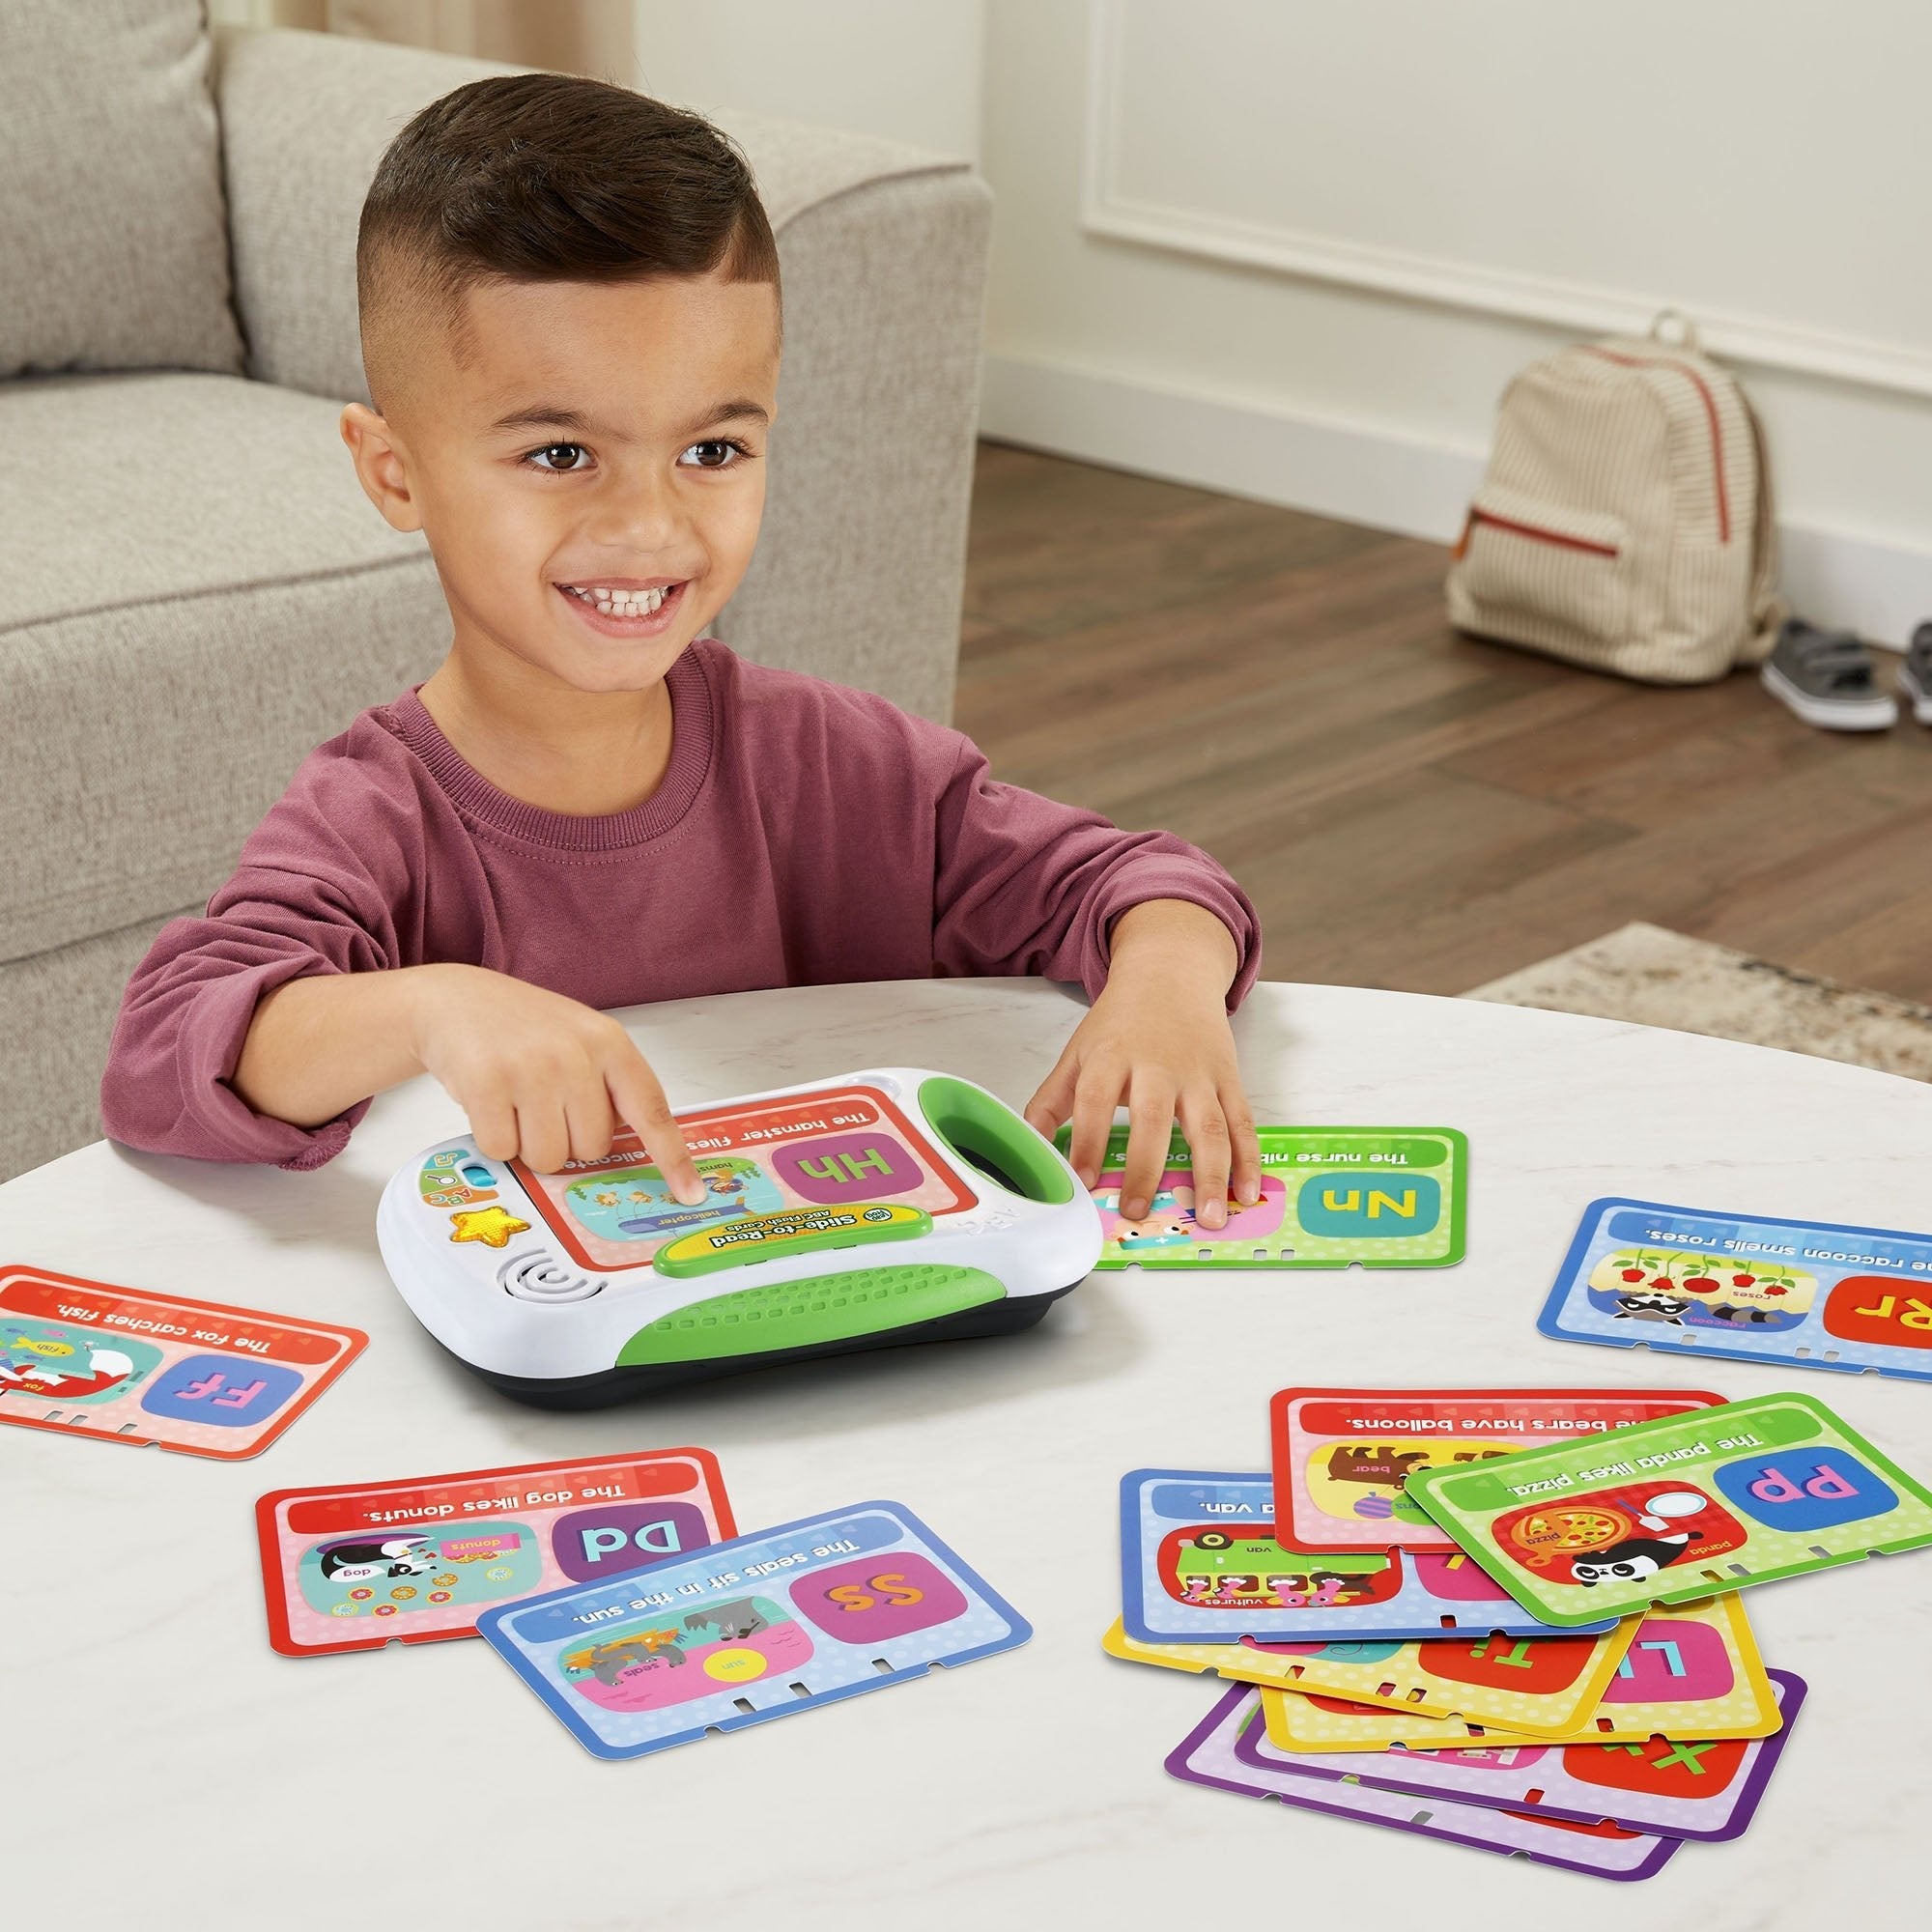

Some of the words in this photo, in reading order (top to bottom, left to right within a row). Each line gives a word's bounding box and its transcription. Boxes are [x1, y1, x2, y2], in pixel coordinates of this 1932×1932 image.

[832, 1111, 870, 1128] The
[741, 1120, 826, 1142] hamster
[686, 1136, 731, 1151] flies
[798, 1148, 895, 1183] Hh
[1294, 1151, 1362, 1163] nurse
[1369, 1151, 1407, 1165] The
[696, 1162, 733, 1174] hams
[1322, 1189, 1416, 1219] Nn
[658, 1209, 721, 1226] helicopter
[766, 1214, 802, 1225] Flash
[803, 1209, 830, 1219] ABC
[710, 1214, 856, 1248] Slide-to-Read
[725, 1220, 765, 1232] Cards
[1645, 1229, 1718, 1247] roses.
[1723, 1239, 1797, 1258] smells
[1803, 1247, 1904, 1270] raccoon
[1732, 1291, 1771, 1301] roses
[57, 1304, 99, 1321] fish.
[104, 1313, 187, 1336] catches
[1690, 1317, 1747, 1330] raccoon
[193, 1329, 230, 1346] fox
[234, 1337, 270, 1353] The
[37, 1343, 61, 1353] fish
[22, 1381, 44, 1392] fox
[172, 1373, 268, 1409] Ff
[1346, 1418, 1453, 1432] balloons.
[1460, 1418, 1524, 1432] have
[1531, 1418, 1607, 1433] bears
[1715, 1434, 1764, 1451] The
[1634, 1441, 1712, 1468] panda
[1577, 1462, 1636, 1483] likes
[1505, 1473, 1571, 1497] pizza.
[1746, 1464, 1860, 1503] Pp
[526, 1488, 574, 1506] dog
[582, 1484, 625, 1501] The
[362, 1503, 454, 1522] donuts.
[462, 1495, 519, 1514] likes
[1198, 1502, 1253, 1515] van.
[449, 1538, 500, 1553] donuts
[580, 1520, 682, 1562] Dd
[1525, 1530, 1561, 1547] pizza
[810, 1538, 860, 1558] The
[1689, 1540, 1732, 1555] panda
[342, 1566, 371, 1579] dog
[743, 1552, 808, 1578] seals
[706, 1571, 740, 1590] sit
[675, 1582, 702, 1598] in
[826, 1574, 923, 1612] Ss
[627, 1591, 674, 1612] the
[1205, 1598, 1264, 1606] vultures
[572, 1605, 621, 1626] sun.
[623, 1663, 661, 1679] seals
[722, 1659, 746, 1672] sun
